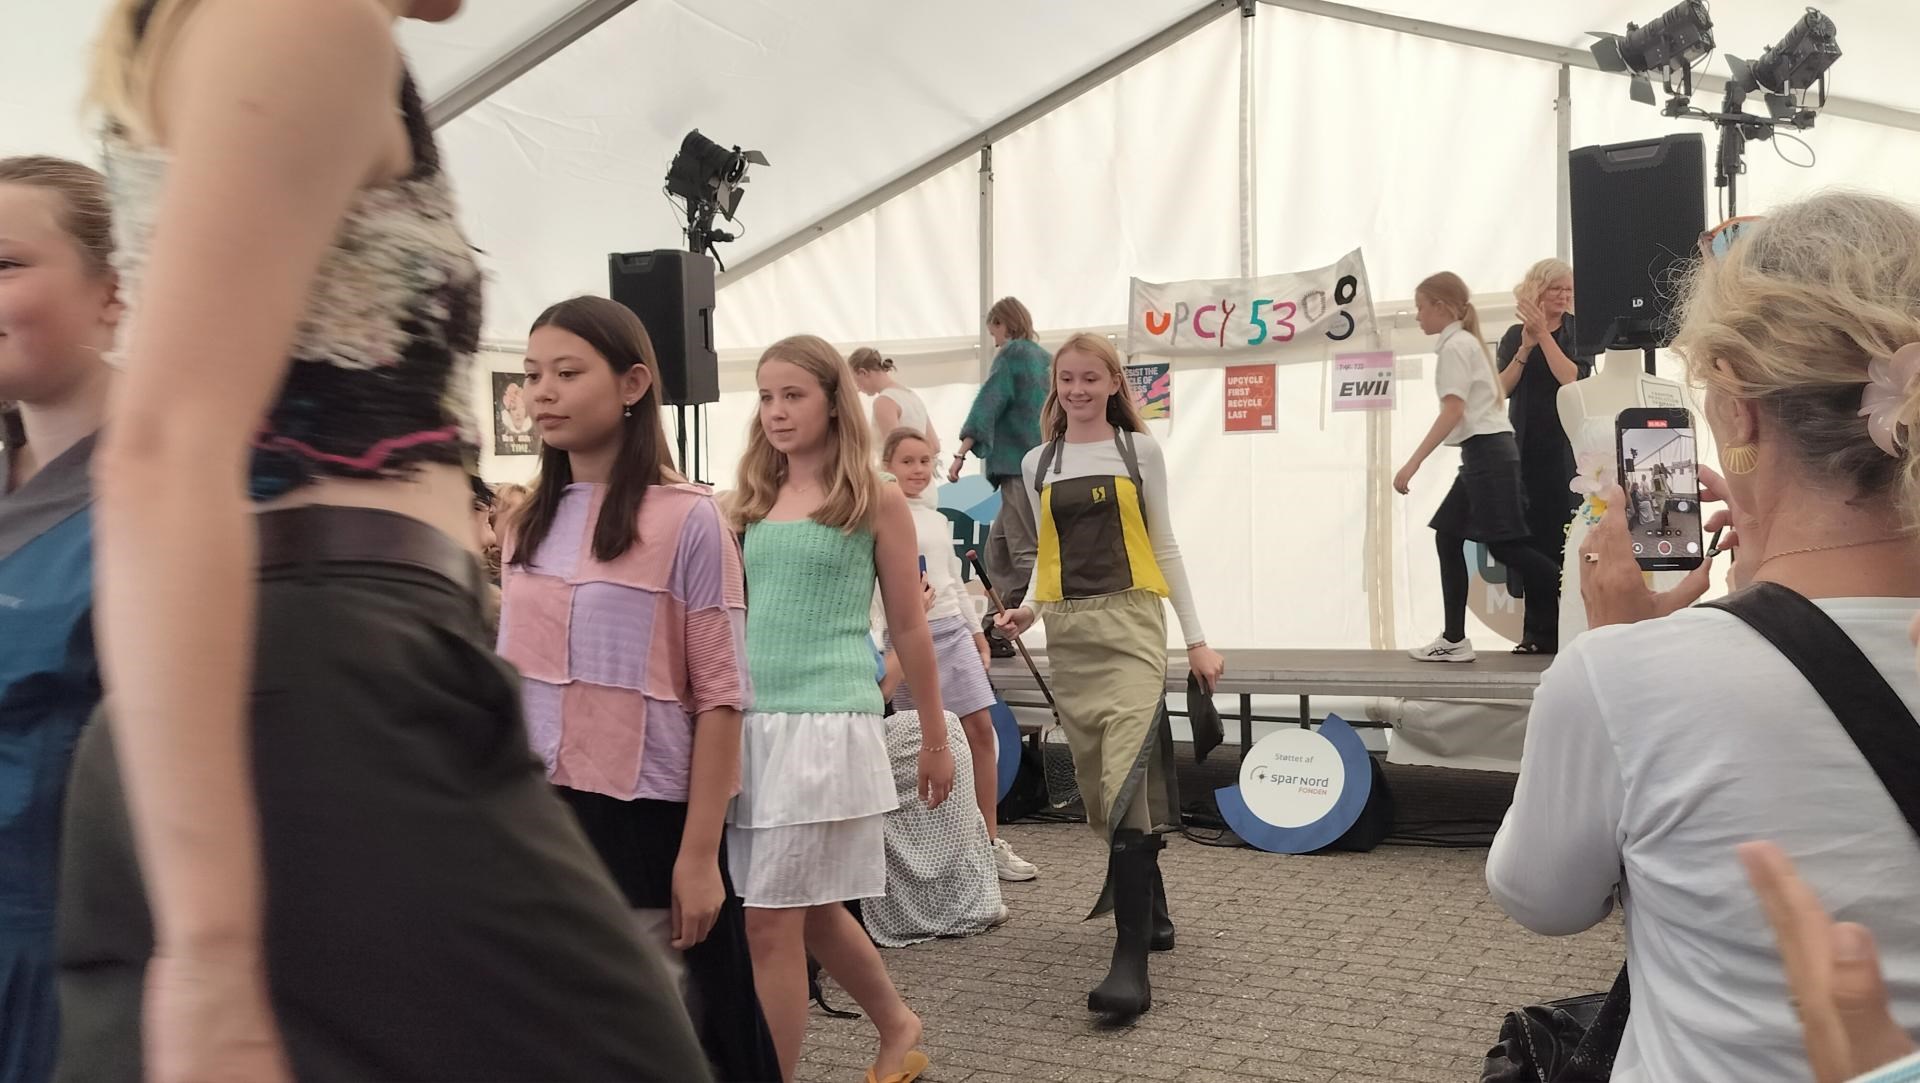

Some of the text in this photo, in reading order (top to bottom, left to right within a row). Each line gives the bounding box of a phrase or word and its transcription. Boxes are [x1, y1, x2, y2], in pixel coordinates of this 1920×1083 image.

[1632, 298, 1644, 308] LD
[1227, 375, 1264, 385] UPCYCLE
[1227, 387, 1250, 396] FIRST
[1227, 399, 1263, 408] RECYCLE
[1227, 411, 1248, 419] LAST
[1274, 753, 1314, 763] Støttet af
[1271, 774, 1298, 786] spar
[1298, 786, 1327, 796] FONDEN
